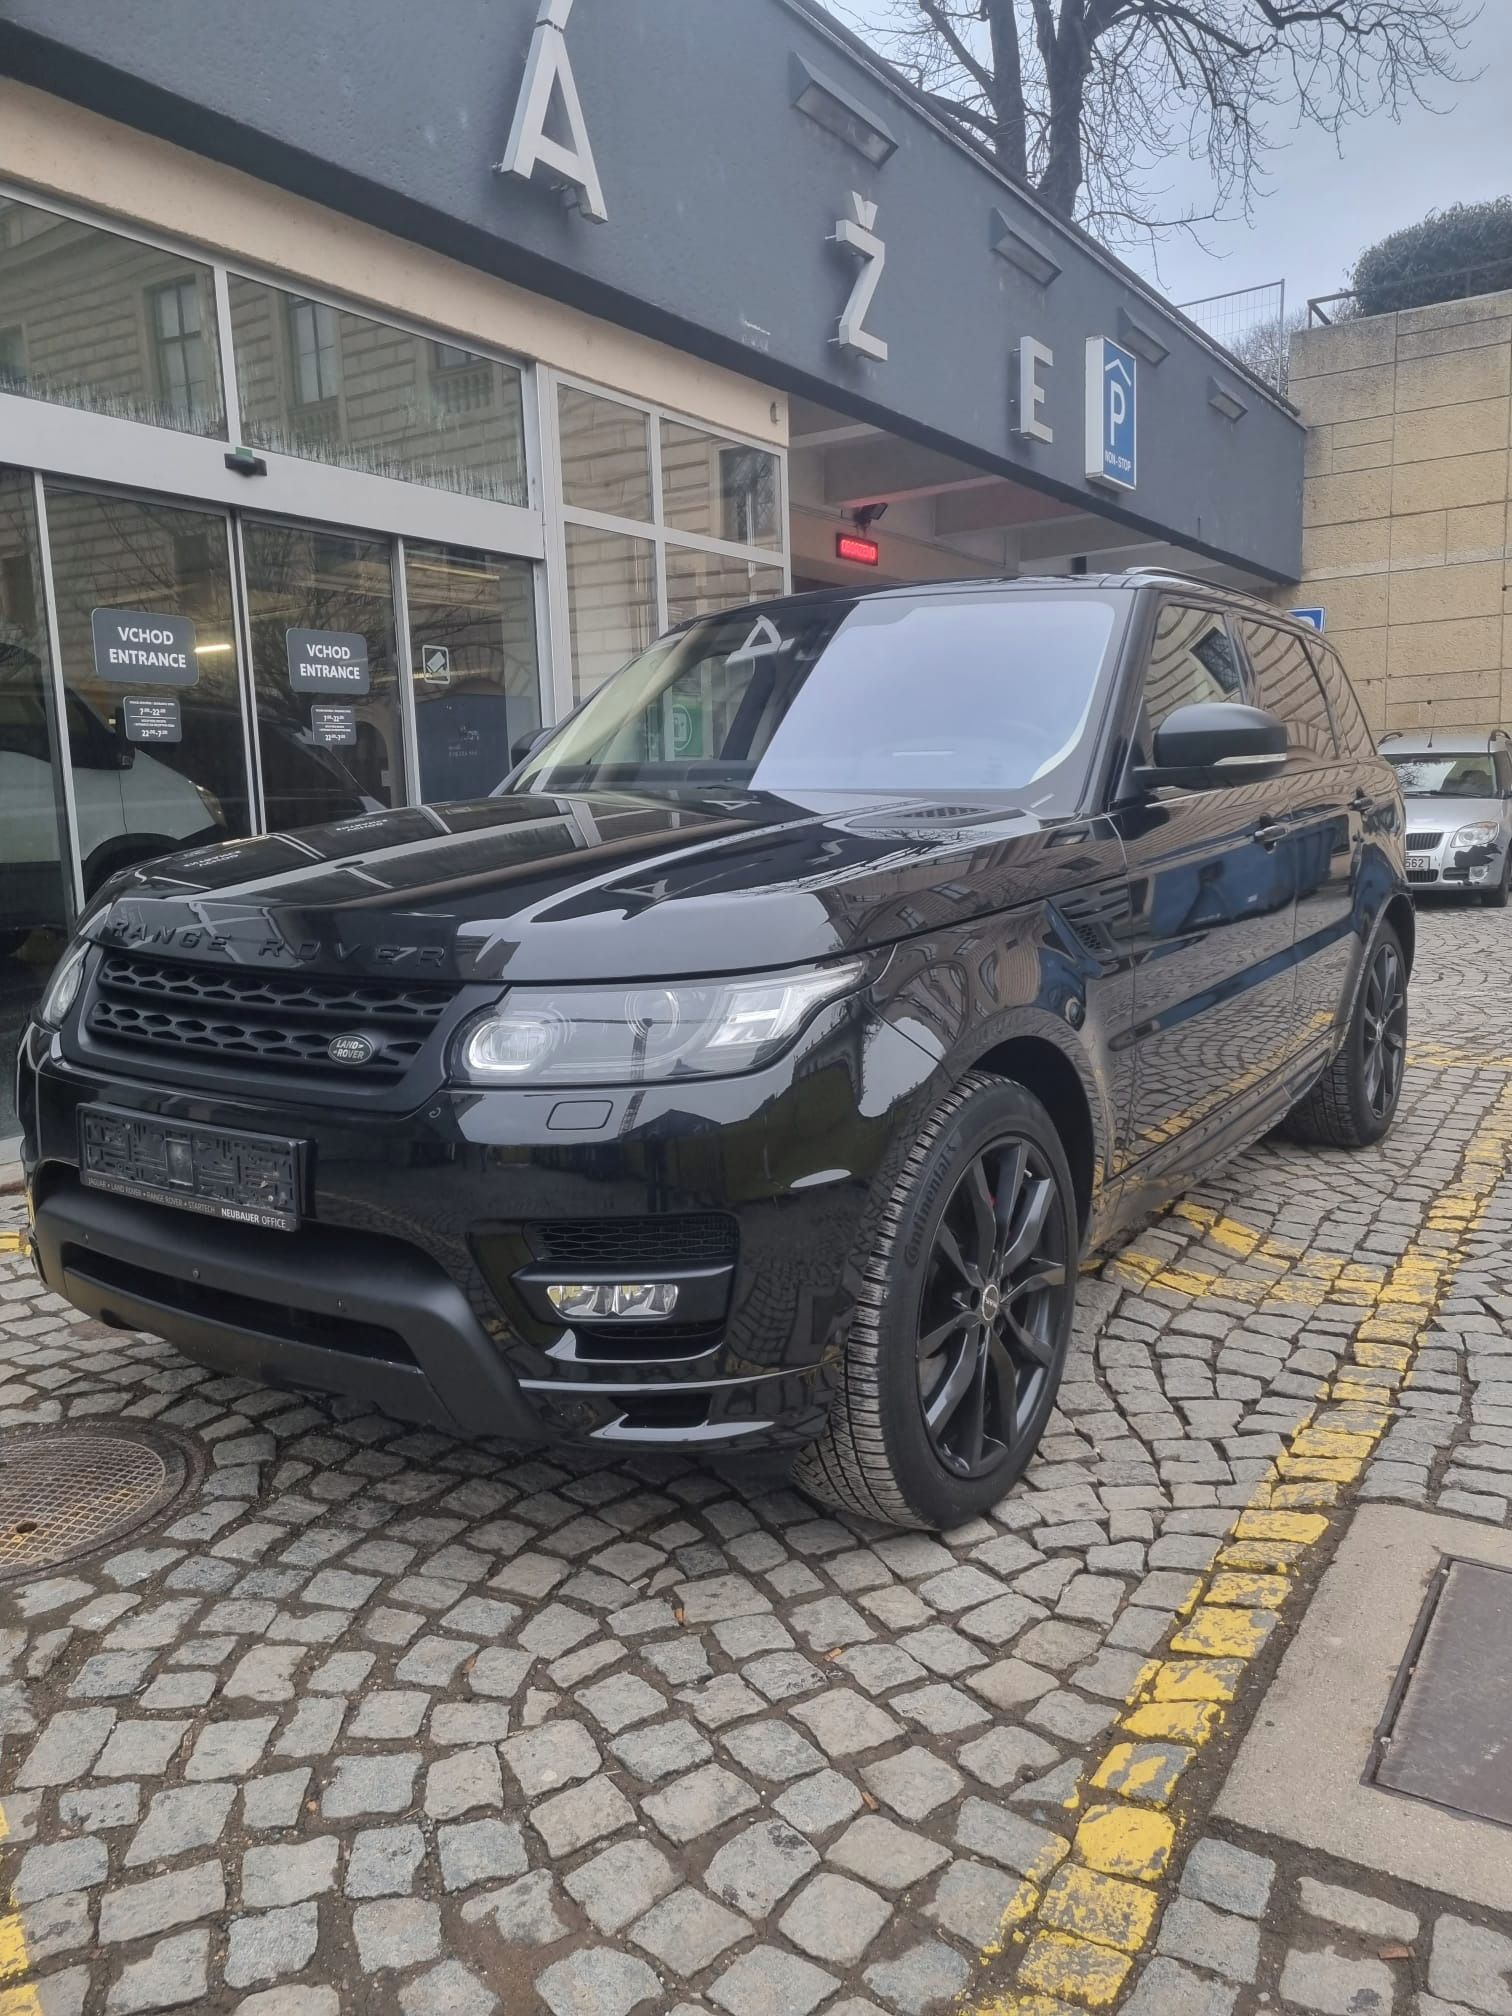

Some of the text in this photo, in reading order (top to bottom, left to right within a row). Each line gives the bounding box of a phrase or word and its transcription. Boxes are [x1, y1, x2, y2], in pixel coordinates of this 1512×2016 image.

[1110, 379, 1126, 446] P
[1104, 449, 1132, 472] NON-STOP
[117, 626, 174, 645] VCHOD
[109, 648, 187, 668] ENTRANCE
[306, 643, 351, 660] VCHOD
[300, 663, 361, 680] ENTRANCE
[109, 920, 447, 968] RANGE ROVER
[336, 1040, 359, 1050] LAND
[336, 1048, 365, 1060] ROVER
[221, 1207, 260, 1224] NEUBAUER
[261, 1214, 287, 1228] OFFICE
[904, 1151, 951, 1268] Continental
